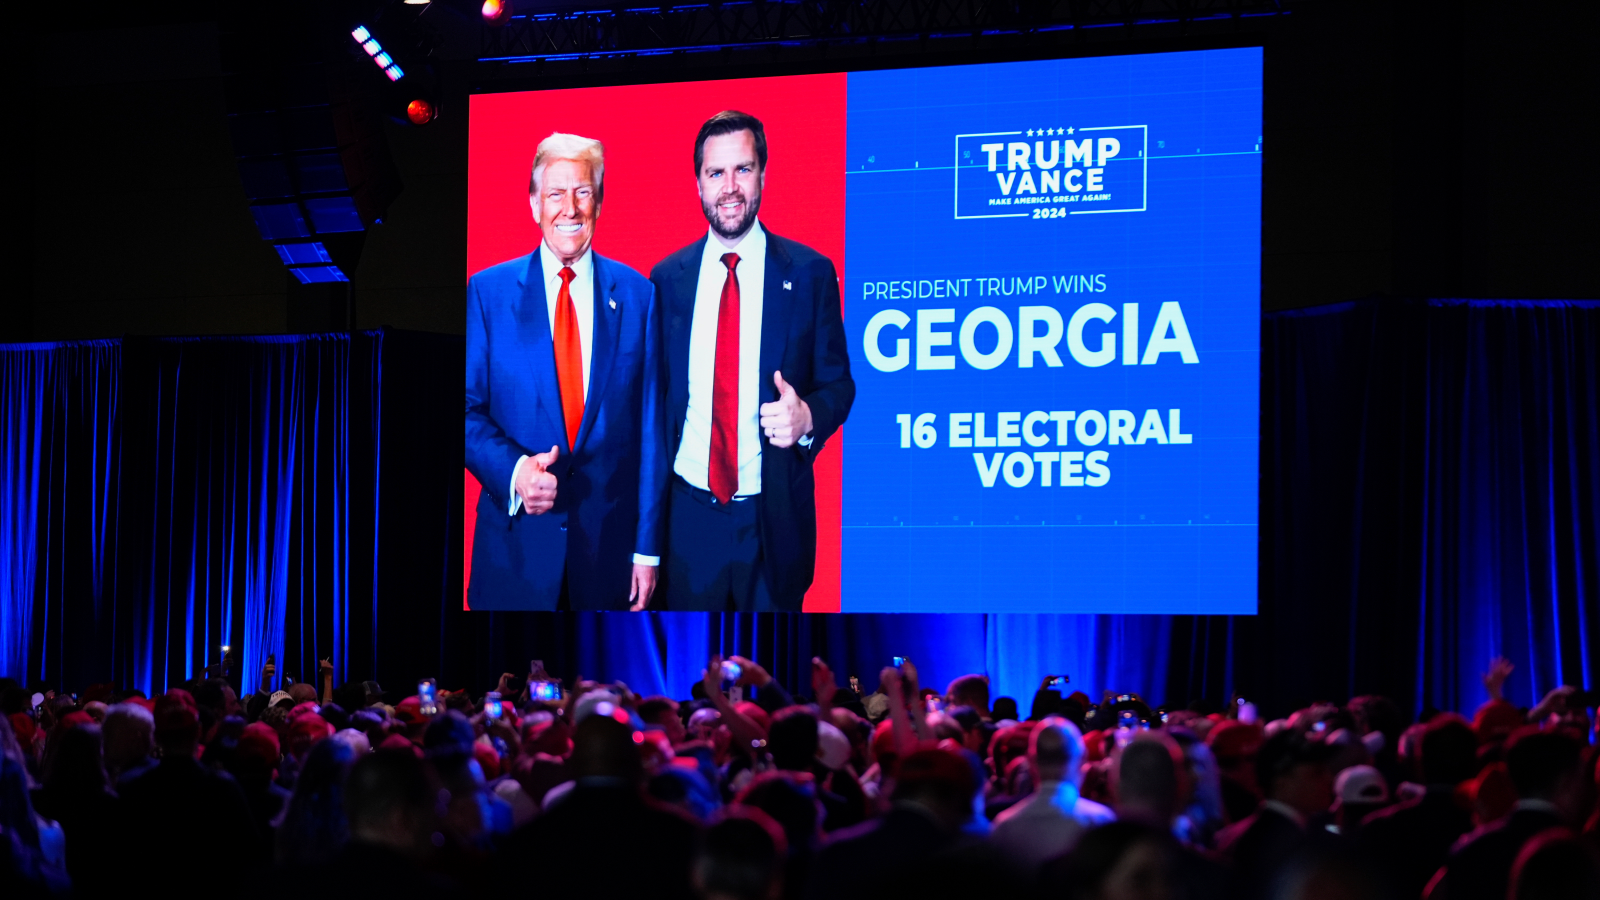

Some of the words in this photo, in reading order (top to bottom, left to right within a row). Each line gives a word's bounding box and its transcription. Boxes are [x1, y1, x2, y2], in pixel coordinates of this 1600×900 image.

[981, 137, 1121, 172] TRUMP
[996, 167, 1104, 196] VANCE
[989, 198, 1012, 206] MAKE
[1013, 196, 1051, 205] AMERICA
[1052, 195, 1080, 203] GREAT
[1081, 193, 1112, 202] AGAIN!
[1032, 207, 1067, 219] 2024
[863, 278, 972, 300] PRESIDENT
[976, 276, 1048, 296] TRUMP
[1052, 274, 1107, 294] WINS
[863, 301, 1200, 373] GEORGIA
[896, 412, 937, 449] 16
[949, 408, 1193, 448] ELECTORAL
[973, 450, 1111, 488] VOTES
